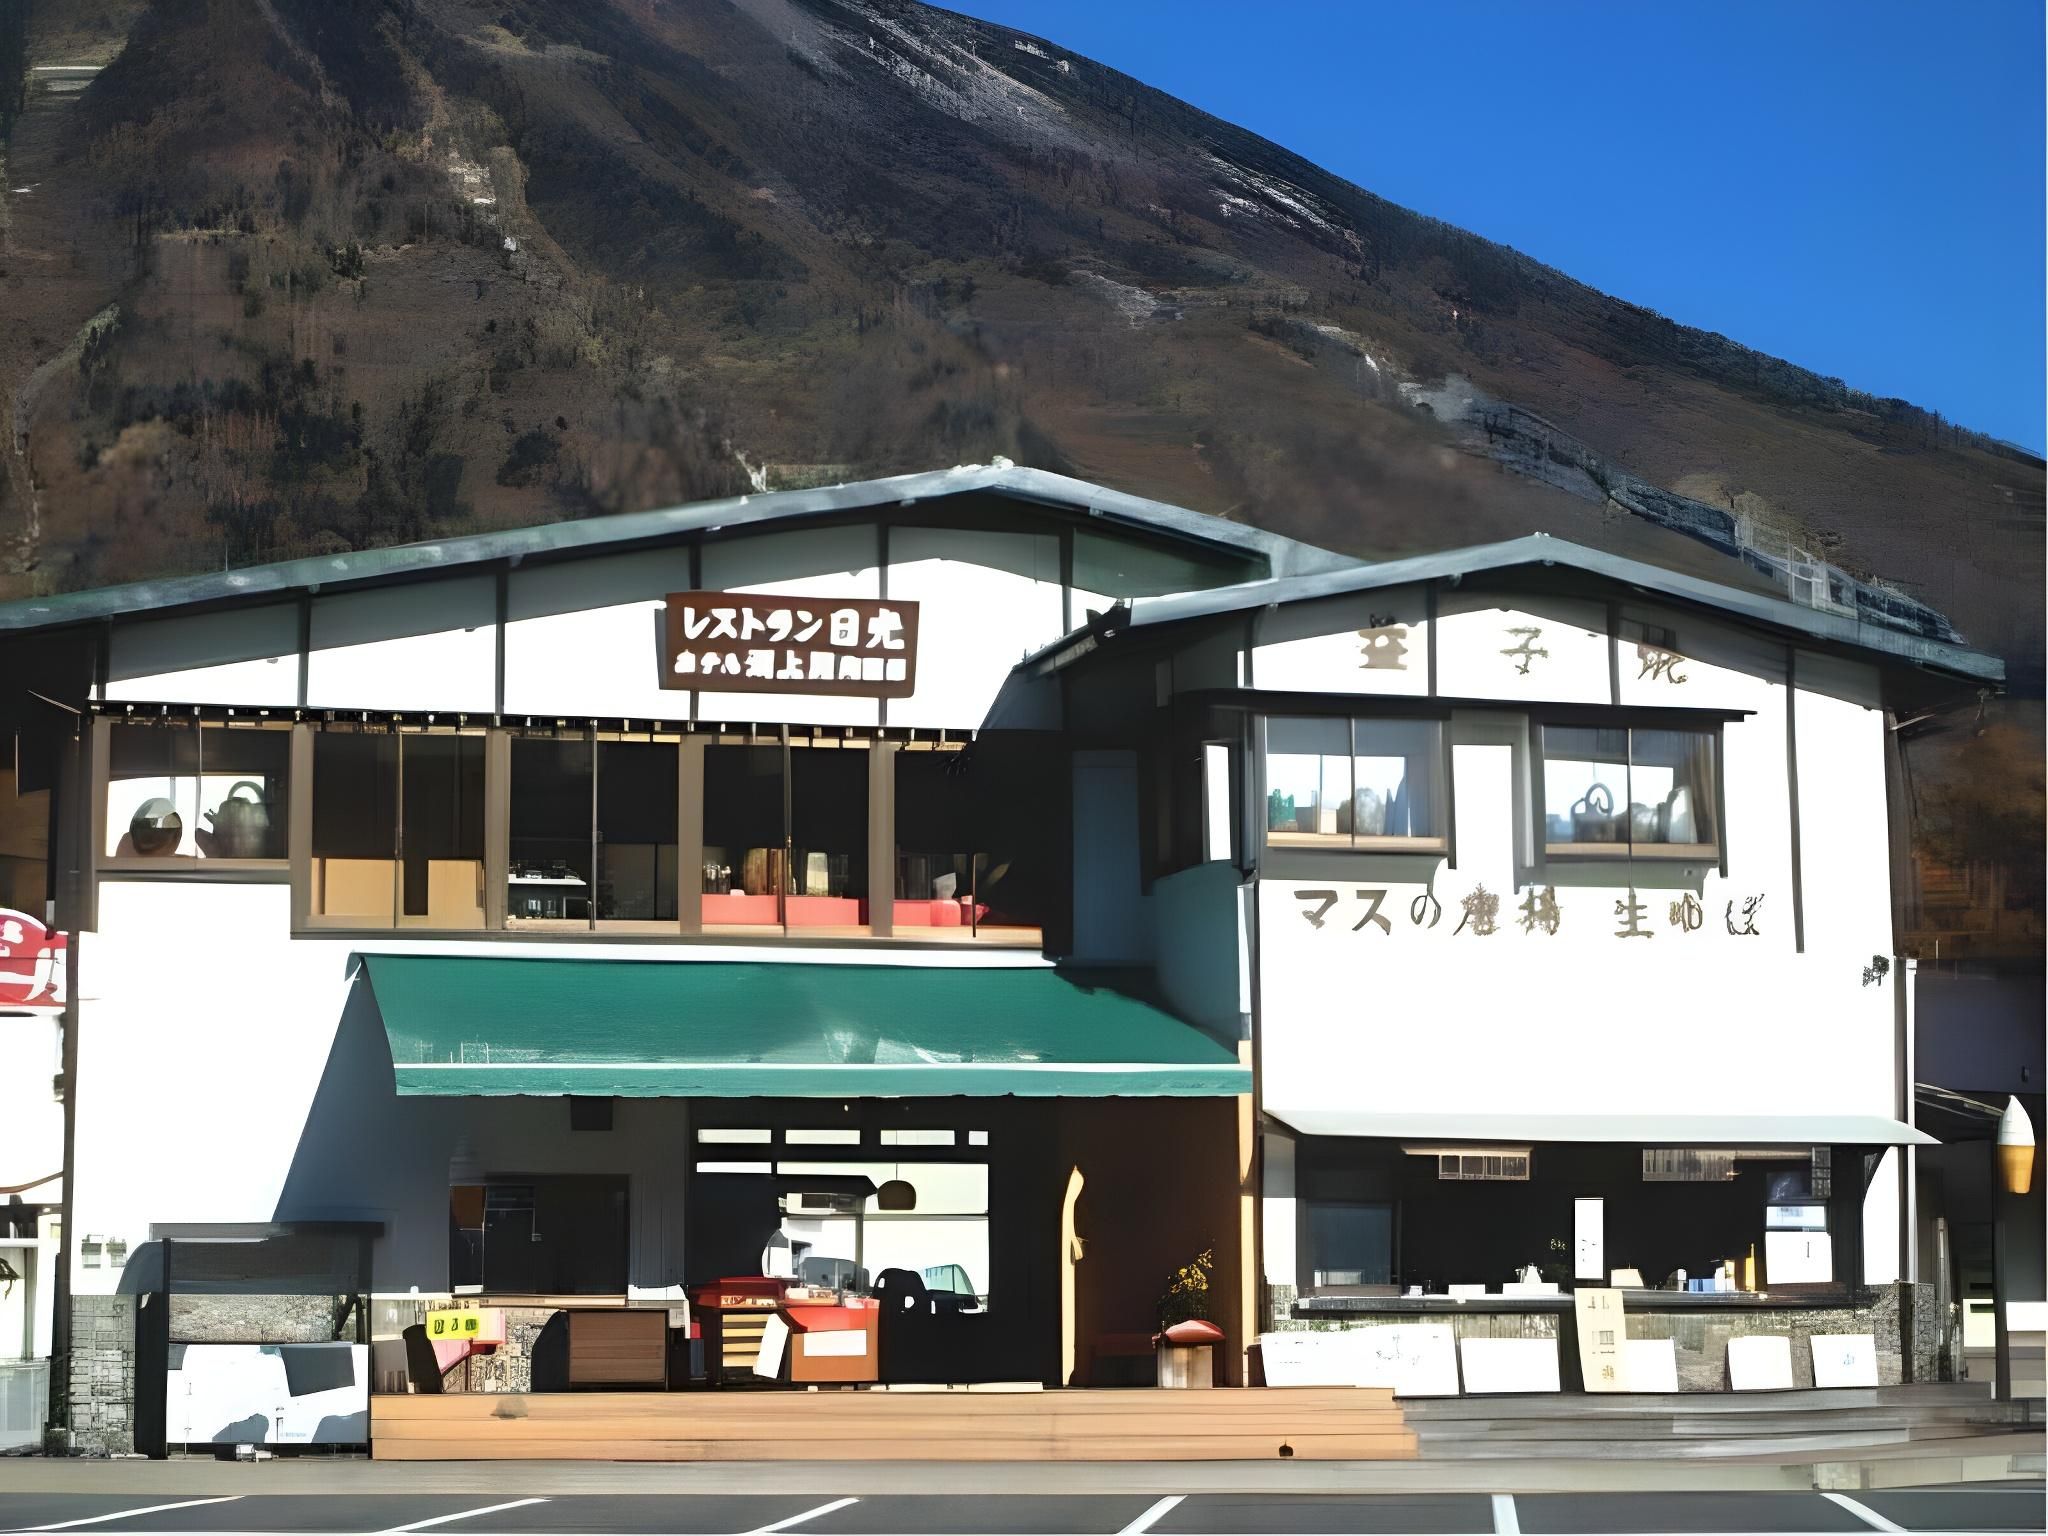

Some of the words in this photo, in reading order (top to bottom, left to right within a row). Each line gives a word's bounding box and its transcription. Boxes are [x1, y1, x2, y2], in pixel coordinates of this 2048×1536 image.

[683, 606, 905, 650] レストラン日光
